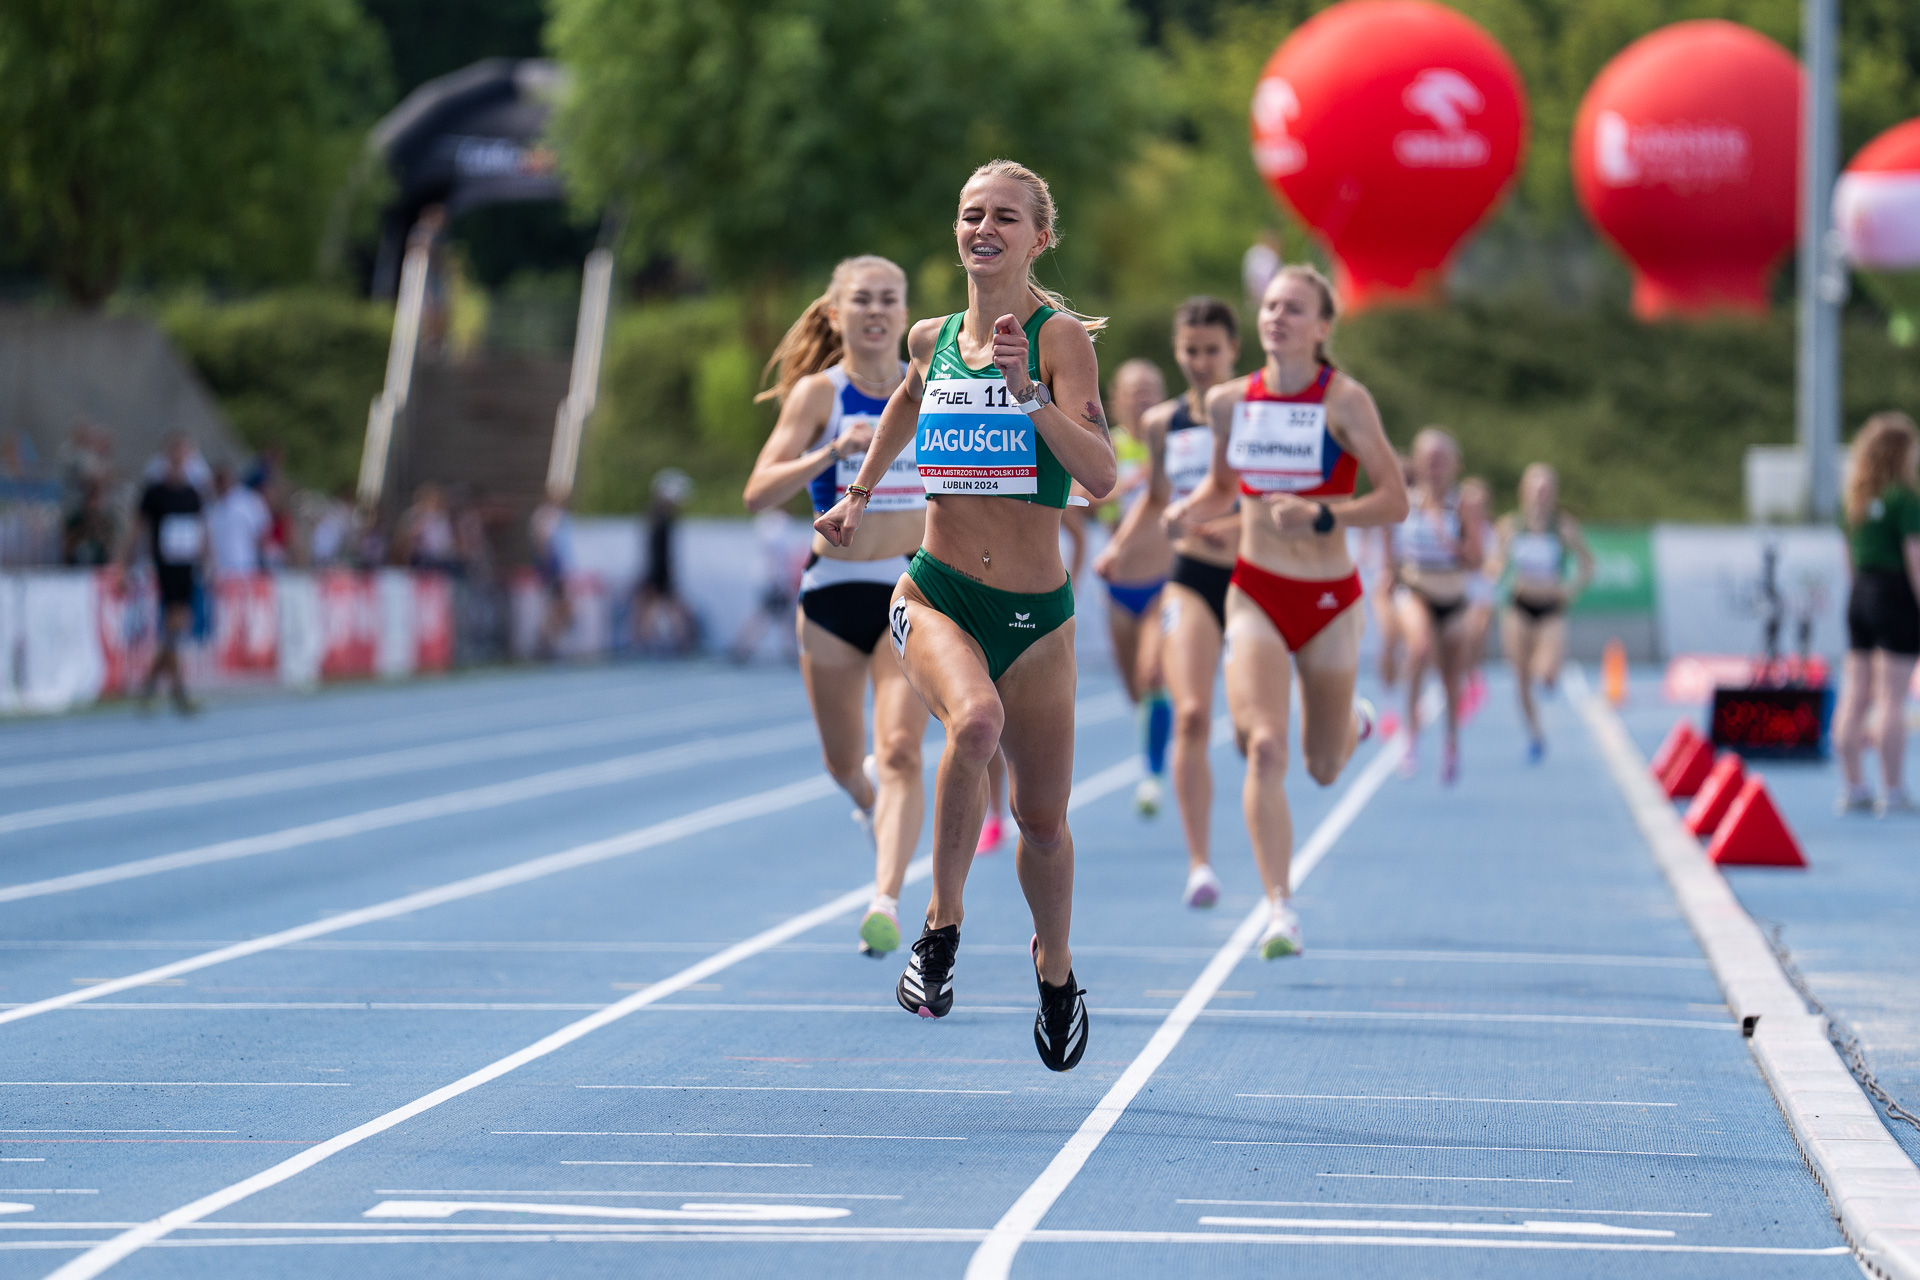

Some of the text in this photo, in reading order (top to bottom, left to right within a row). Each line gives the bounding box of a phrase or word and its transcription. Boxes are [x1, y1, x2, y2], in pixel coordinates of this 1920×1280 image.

[937, 391, 973, 405] FUEL
[984, 385, 1018, 408] 11
[920, 424, 1028, 452] JAGUŚCIK
[926, 468, 942, 476] PZLA
[942, 469, 988, 477] MISTRZOSTWA
[989, 469, 1014, 477] POLSKI
[1015, 468, 1030, 476] U23
[943, 480, 999, 490] LUBLIN 2024
